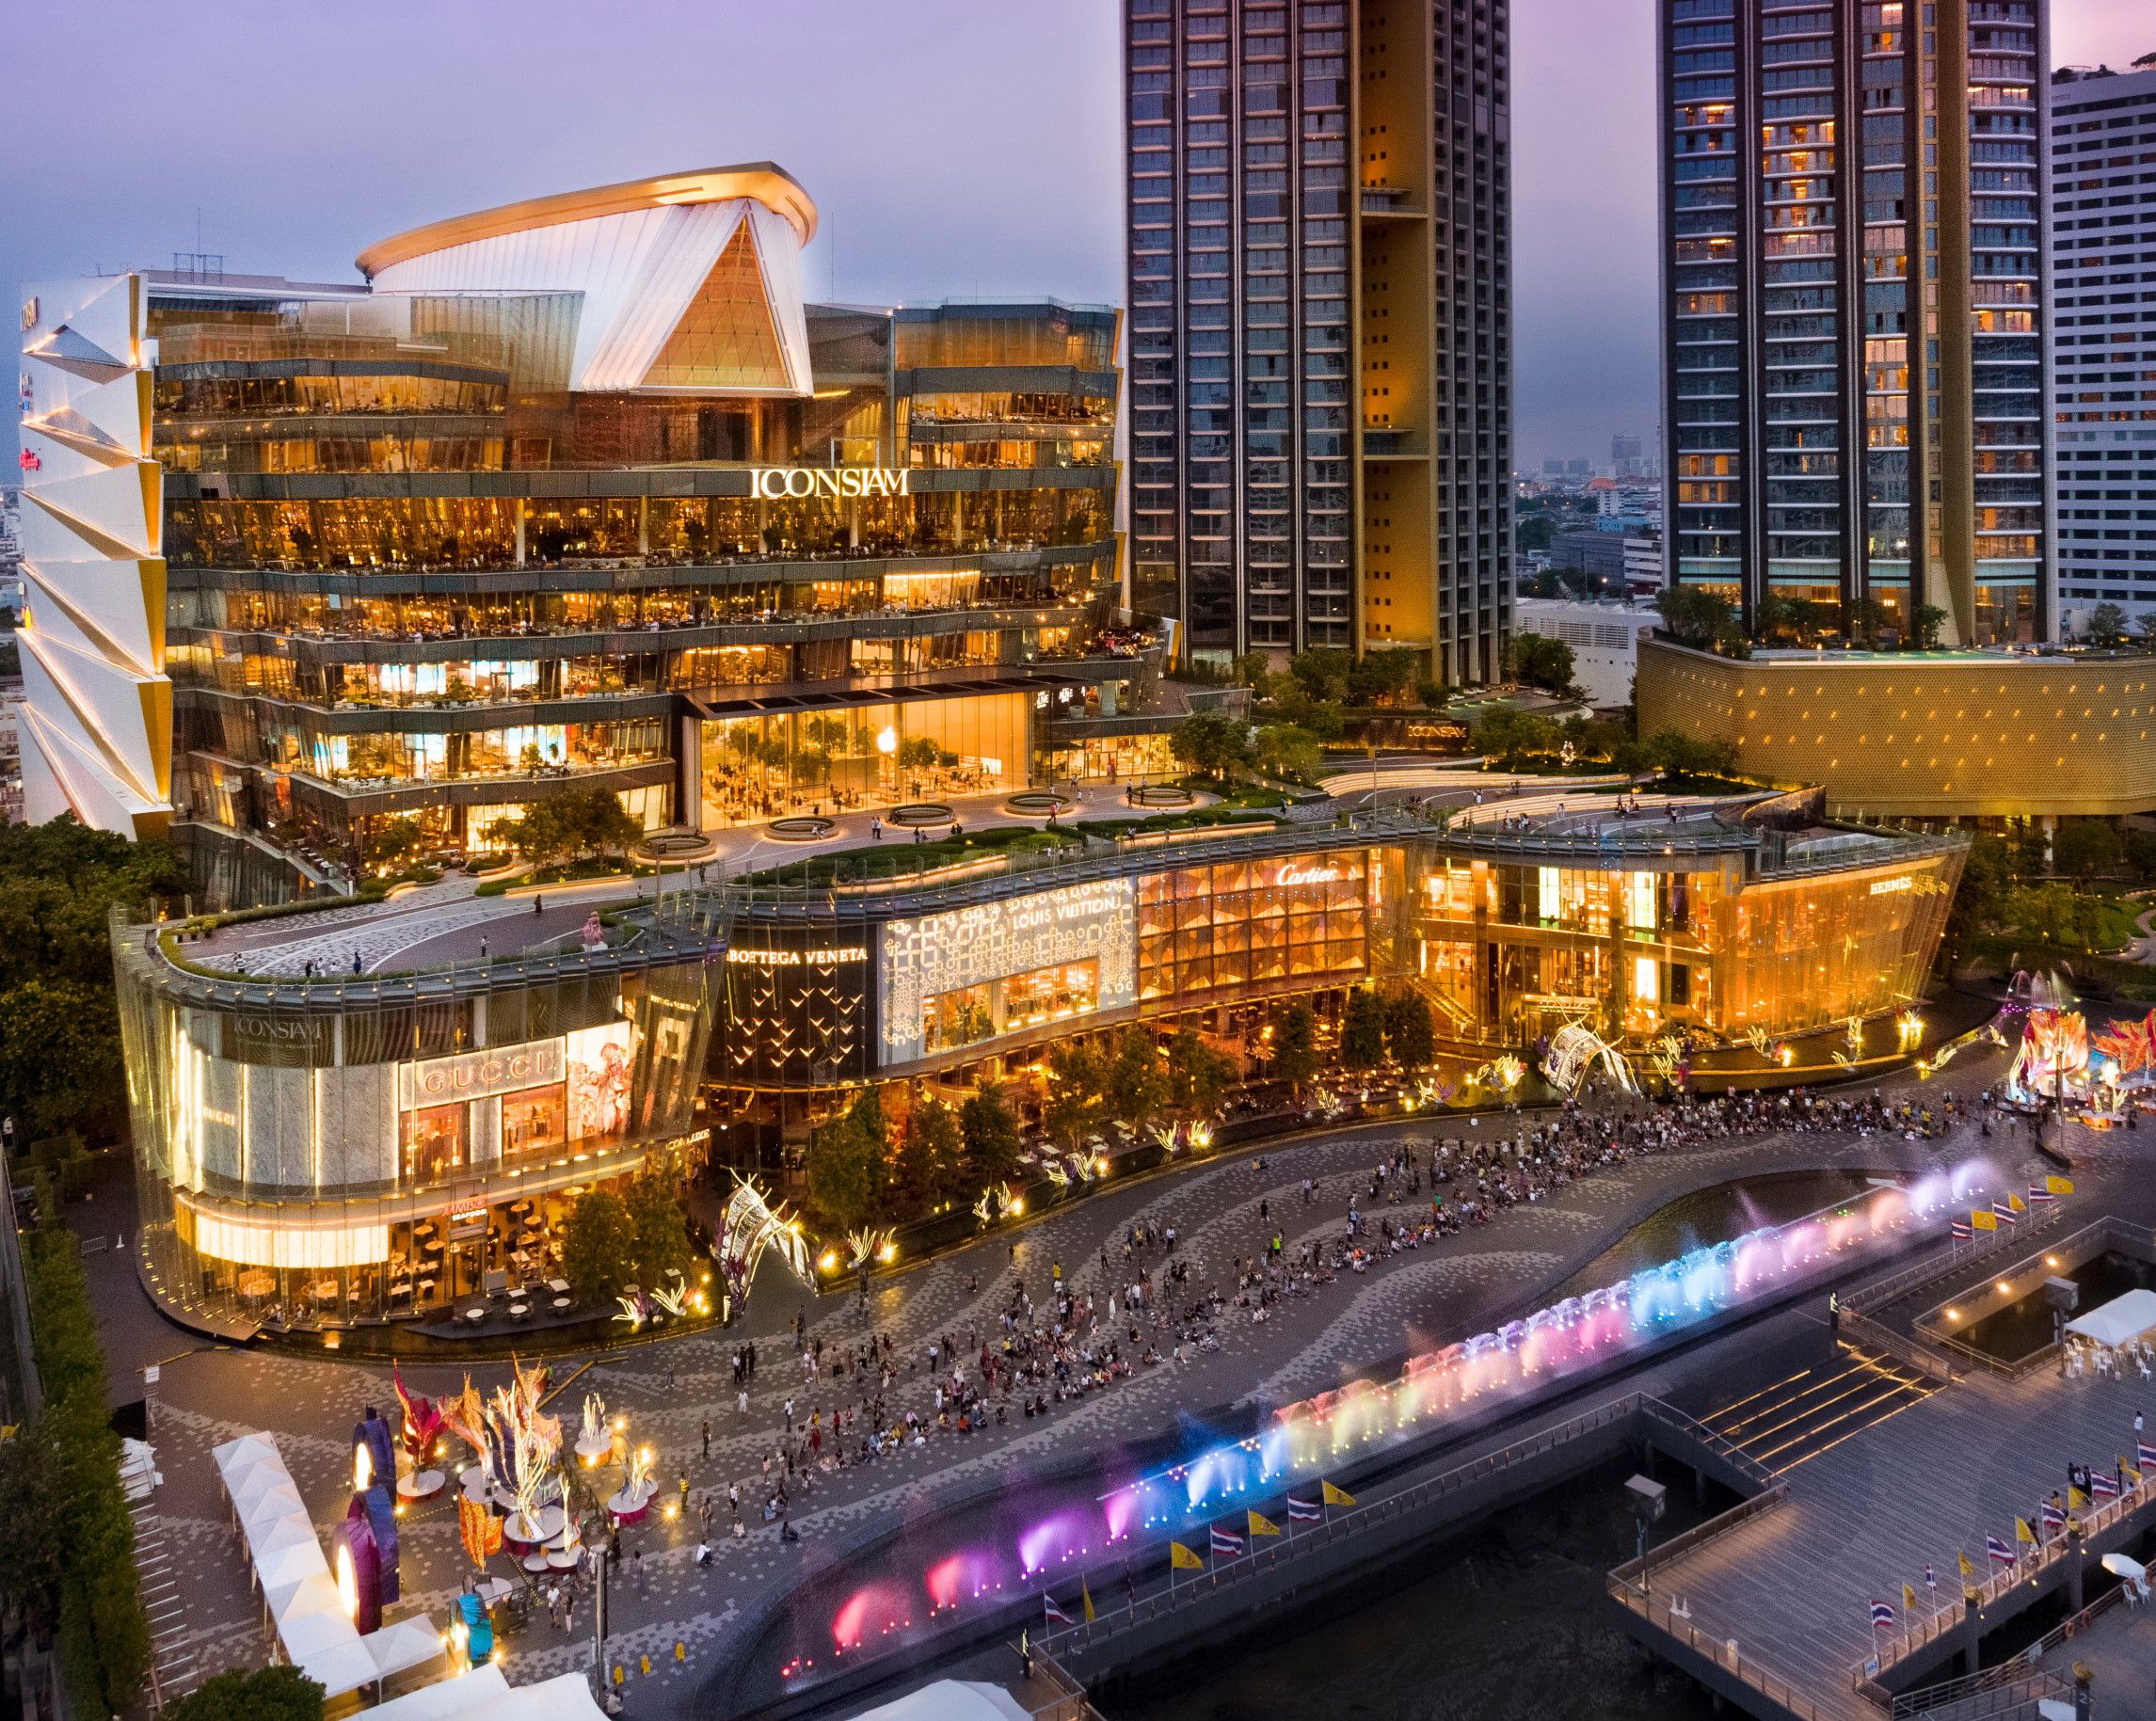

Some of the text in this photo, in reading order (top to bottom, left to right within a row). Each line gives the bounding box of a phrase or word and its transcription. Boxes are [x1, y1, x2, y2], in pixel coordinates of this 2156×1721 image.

[750, 469, 910, 499] ICONSIAM
[1408, 725, 1467, 738] ICONSIAM
[1276, 864, 1338, 885] Cartier
[1013, 896, 1118, 930] LOUIS VUITTON
[728, 948, 868, 964] BOTTEGA VENETA
[233, 1017, 322, 1039] ICONSIAM
[423, 1051, 545, 1094] GUCCI
[2079, 1693, 2087, 1704] 2
